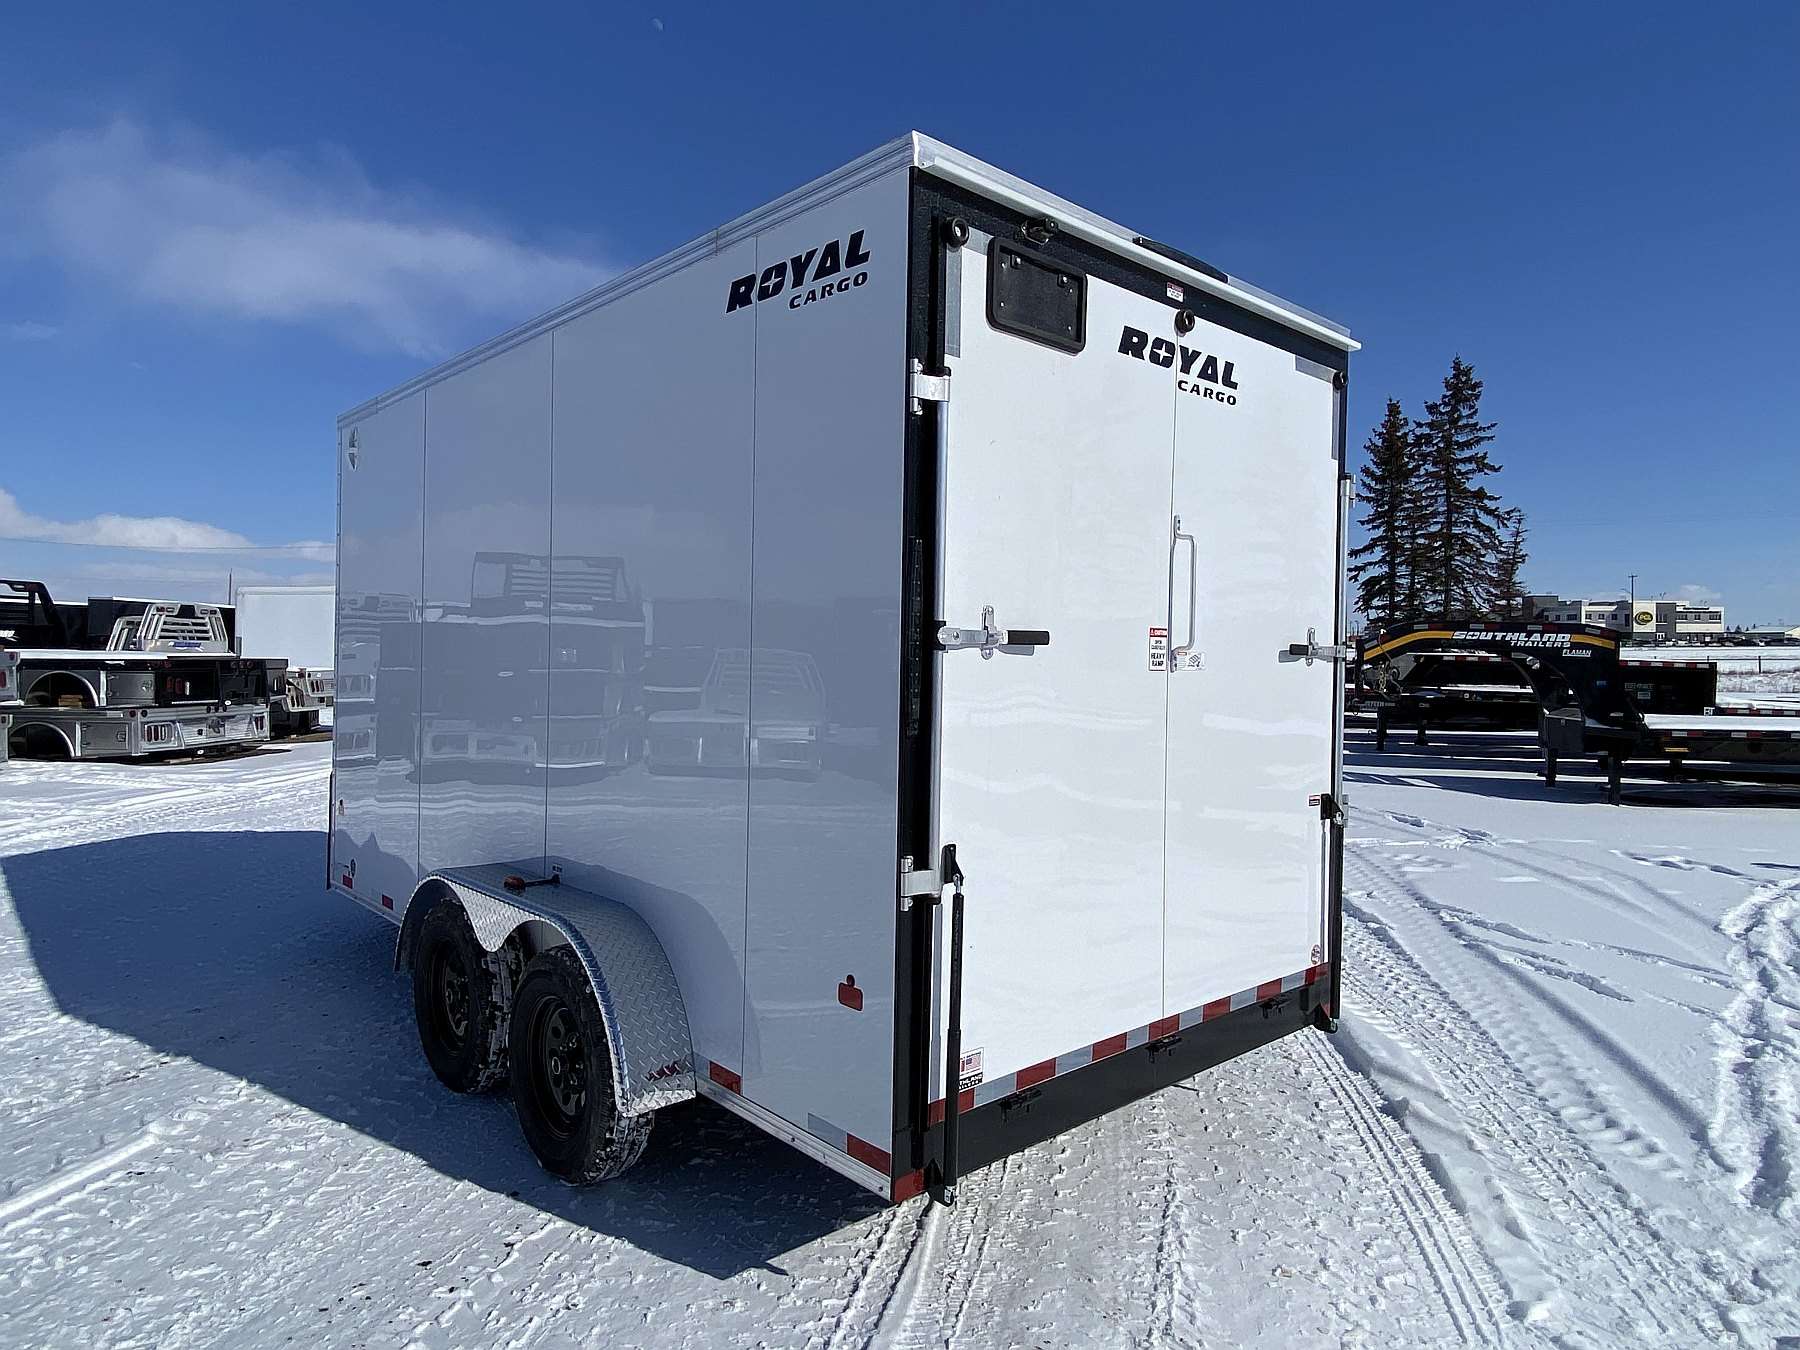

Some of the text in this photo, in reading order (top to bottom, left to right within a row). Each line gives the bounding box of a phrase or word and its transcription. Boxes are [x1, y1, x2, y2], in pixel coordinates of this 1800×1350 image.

[726, 229, 870, 313] ROYAL
[788, 271, 868, 309] CARGO
[1117, 325, 1239, 391] ROYAL
[1177, 379, 1237, 406] CARGO
[1452, 631, 1571, 642] SOUTHLAND
[1510, 640, 1571, 648] TRAILERS
[1562, 648, 1592, 657] FLAMAN
